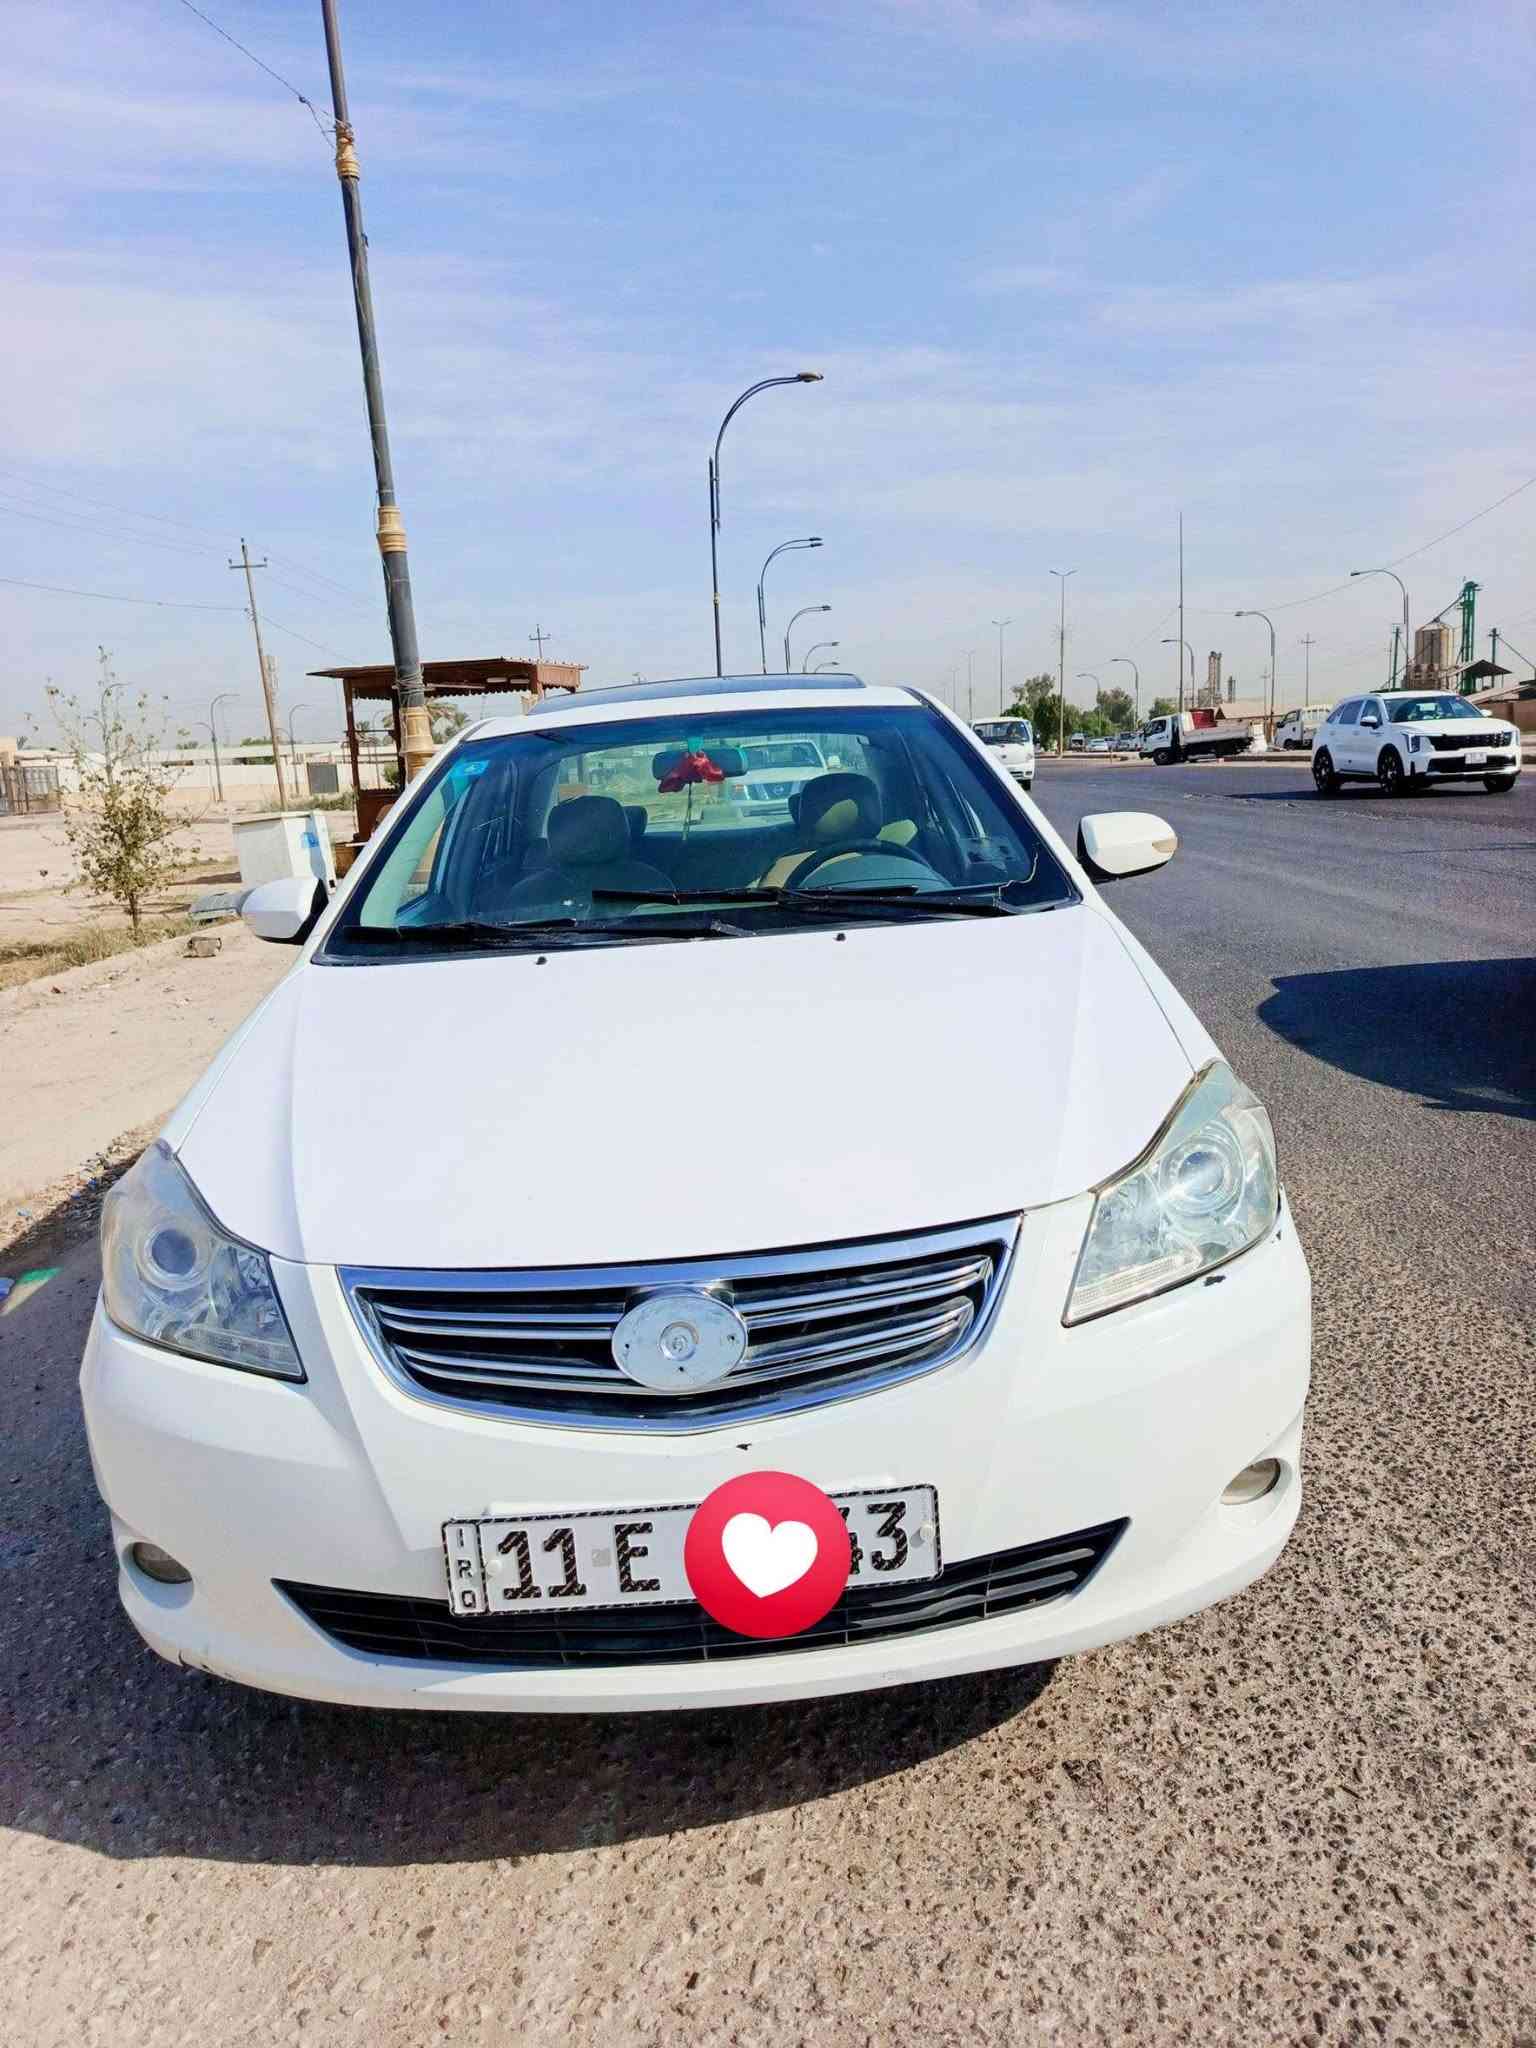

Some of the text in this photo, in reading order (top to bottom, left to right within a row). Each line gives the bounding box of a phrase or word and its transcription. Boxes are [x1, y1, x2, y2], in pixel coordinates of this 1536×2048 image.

[457, 1527, 477, 1609] IRQ
[498, 1527, 587, 1600] 11
[614, 1522, 661, 1592] E
